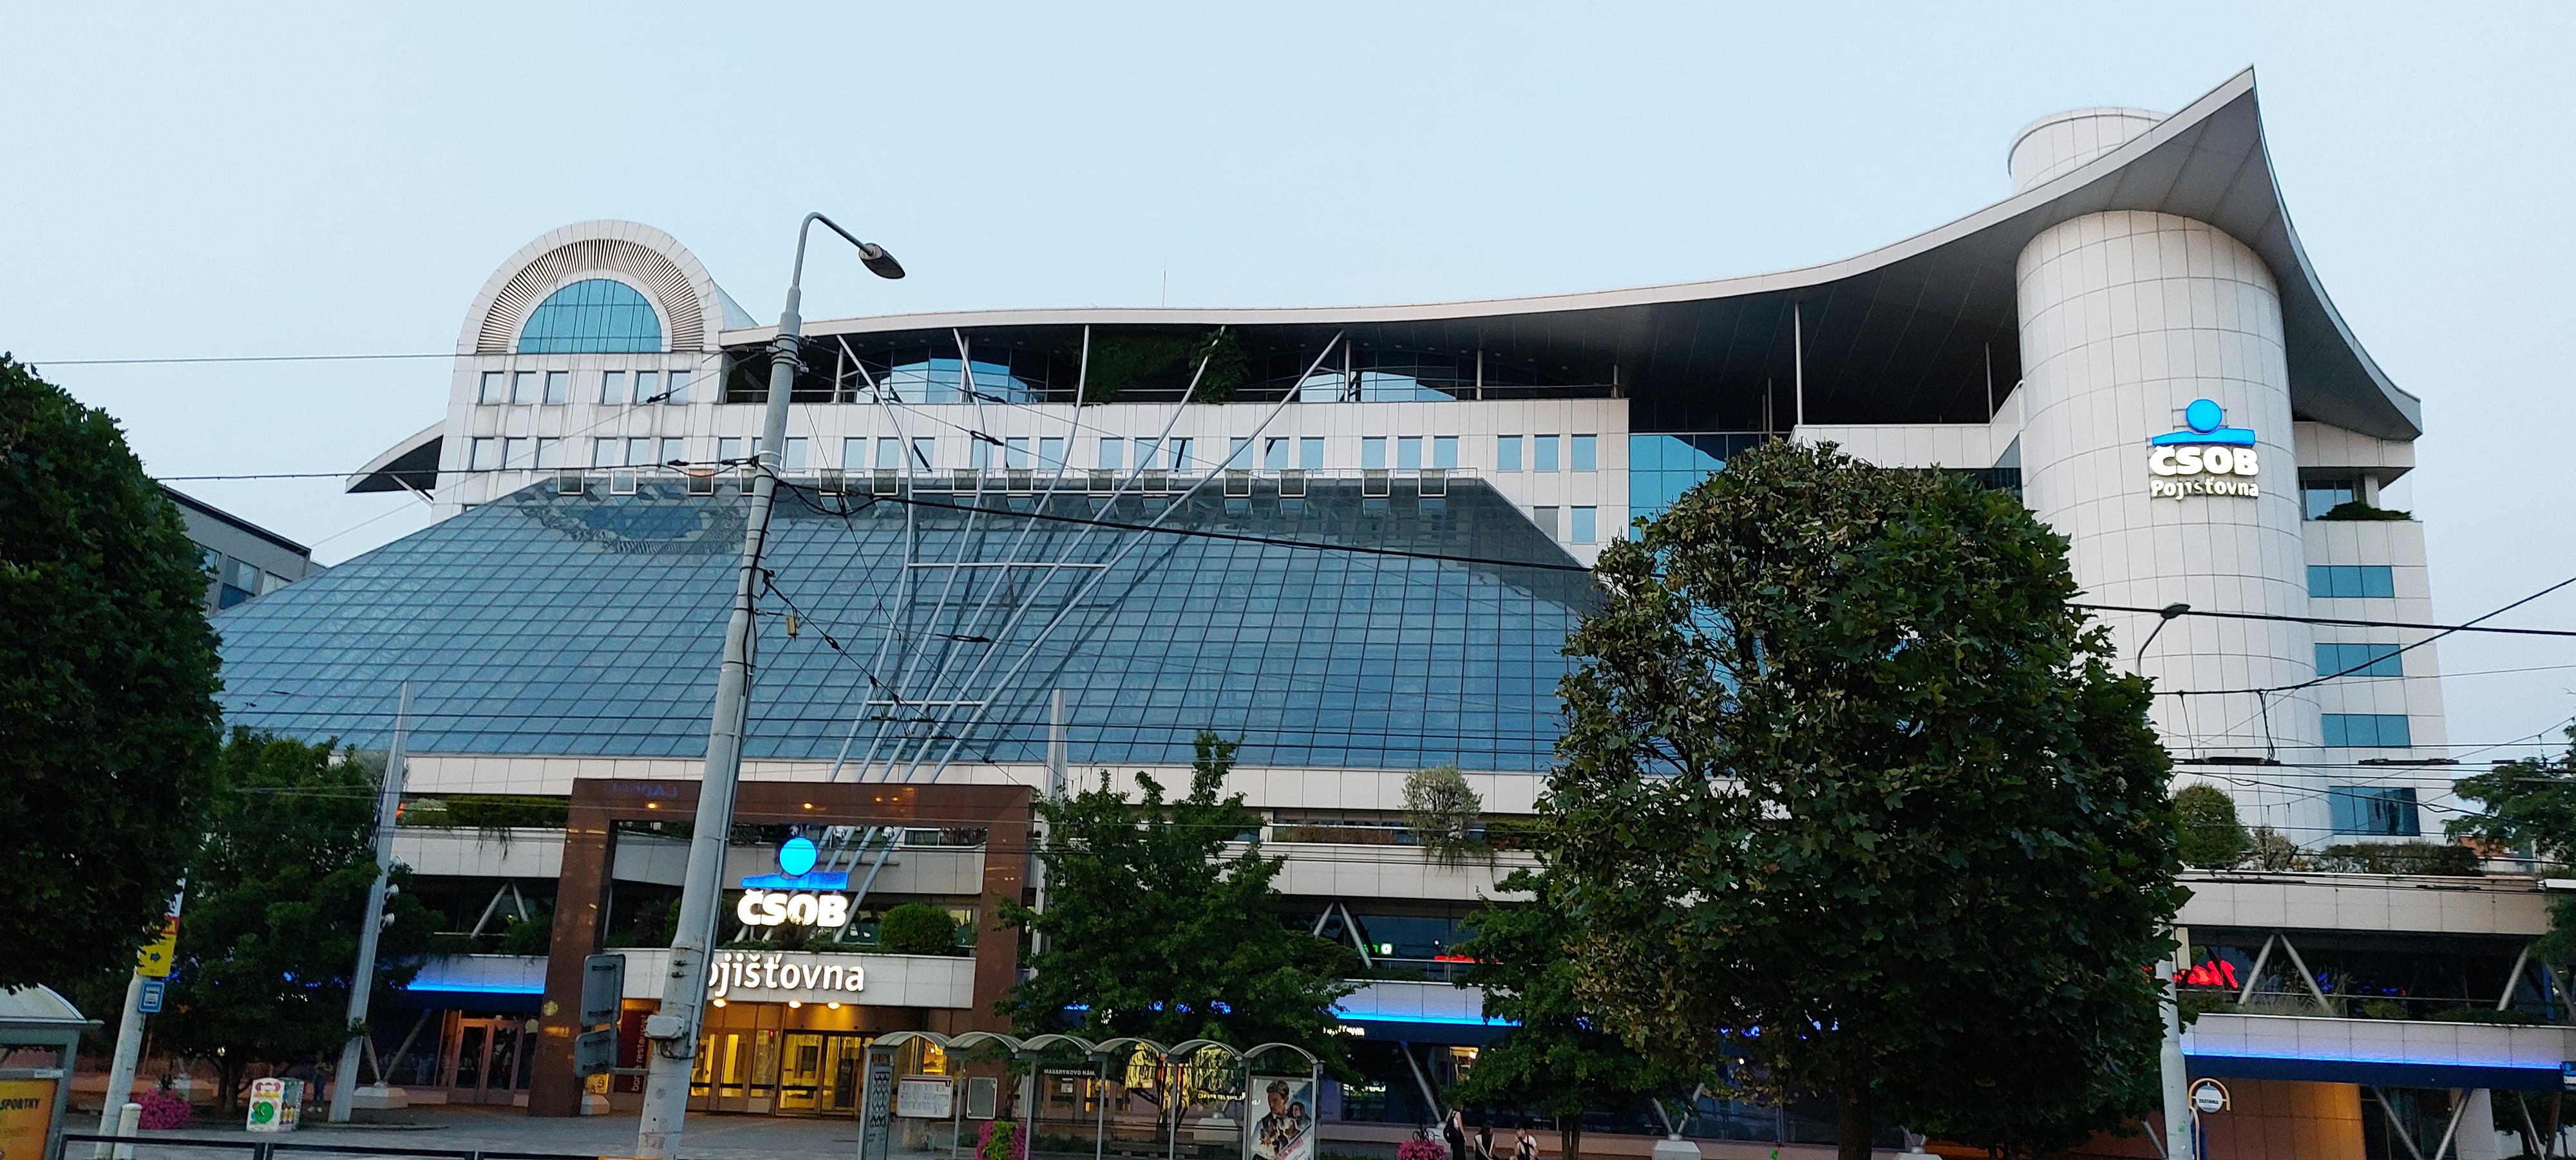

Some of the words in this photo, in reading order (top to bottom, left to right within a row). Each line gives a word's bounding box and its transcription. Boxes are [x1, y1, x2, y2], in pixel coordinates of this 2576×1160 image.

[2150, 445, 2259, 476] ČSOB
[2151, 476, 2259, 500] Pojišťovna
[737, 888, 849, 927] ČSOB
